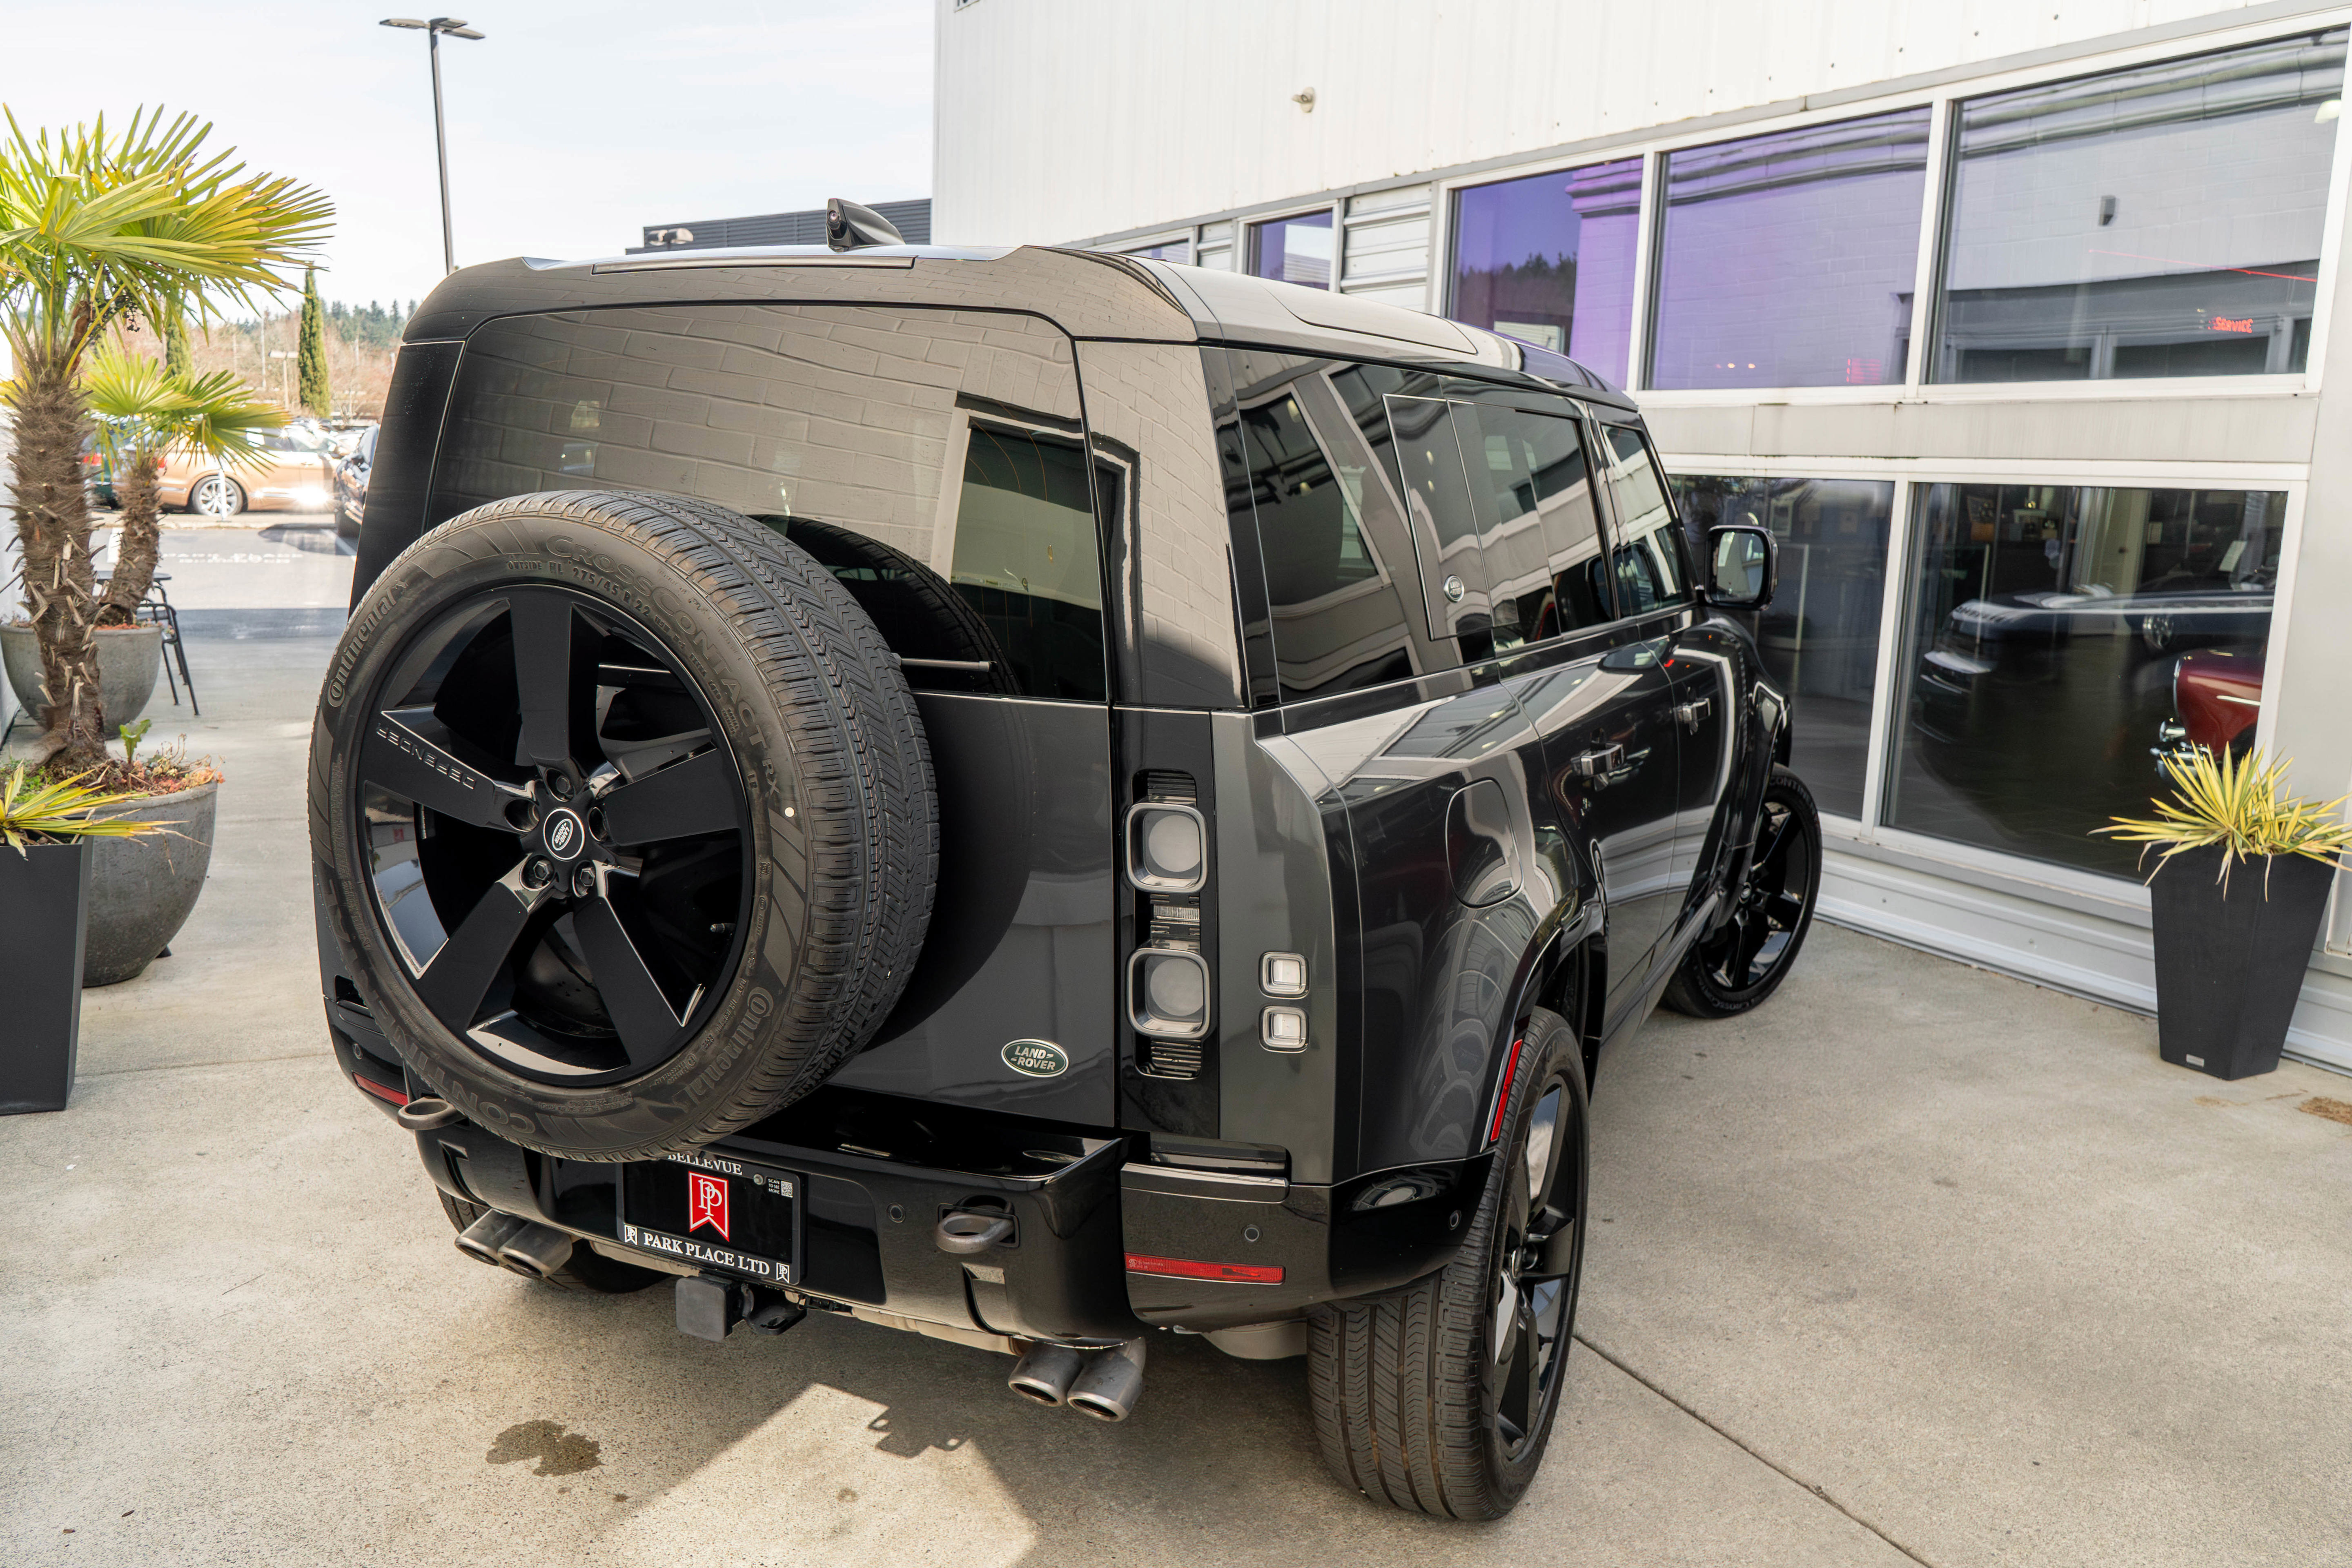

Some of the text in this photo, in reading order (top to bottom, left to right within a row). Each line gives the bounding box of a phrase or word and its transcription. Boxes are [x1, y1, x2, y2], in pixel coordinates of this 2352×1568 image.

[507, 559, 542, 571] OUTSIDE
[573, 567, 619, 596] 275/45
[635, 599, 651, 616] 22
[327, 587, 396, 707] Continental
[376, 723, 477, 790] DEFENDER
[555, 824, 566, 844] ROVER
[560, 826, 570, 843] LAND
[1015, 1046, 1047, 1059] LAND
[1016, 1057, 1056, 1071] ROVER
[644, 1232, 770, 1275] PARK PLACE LTD
